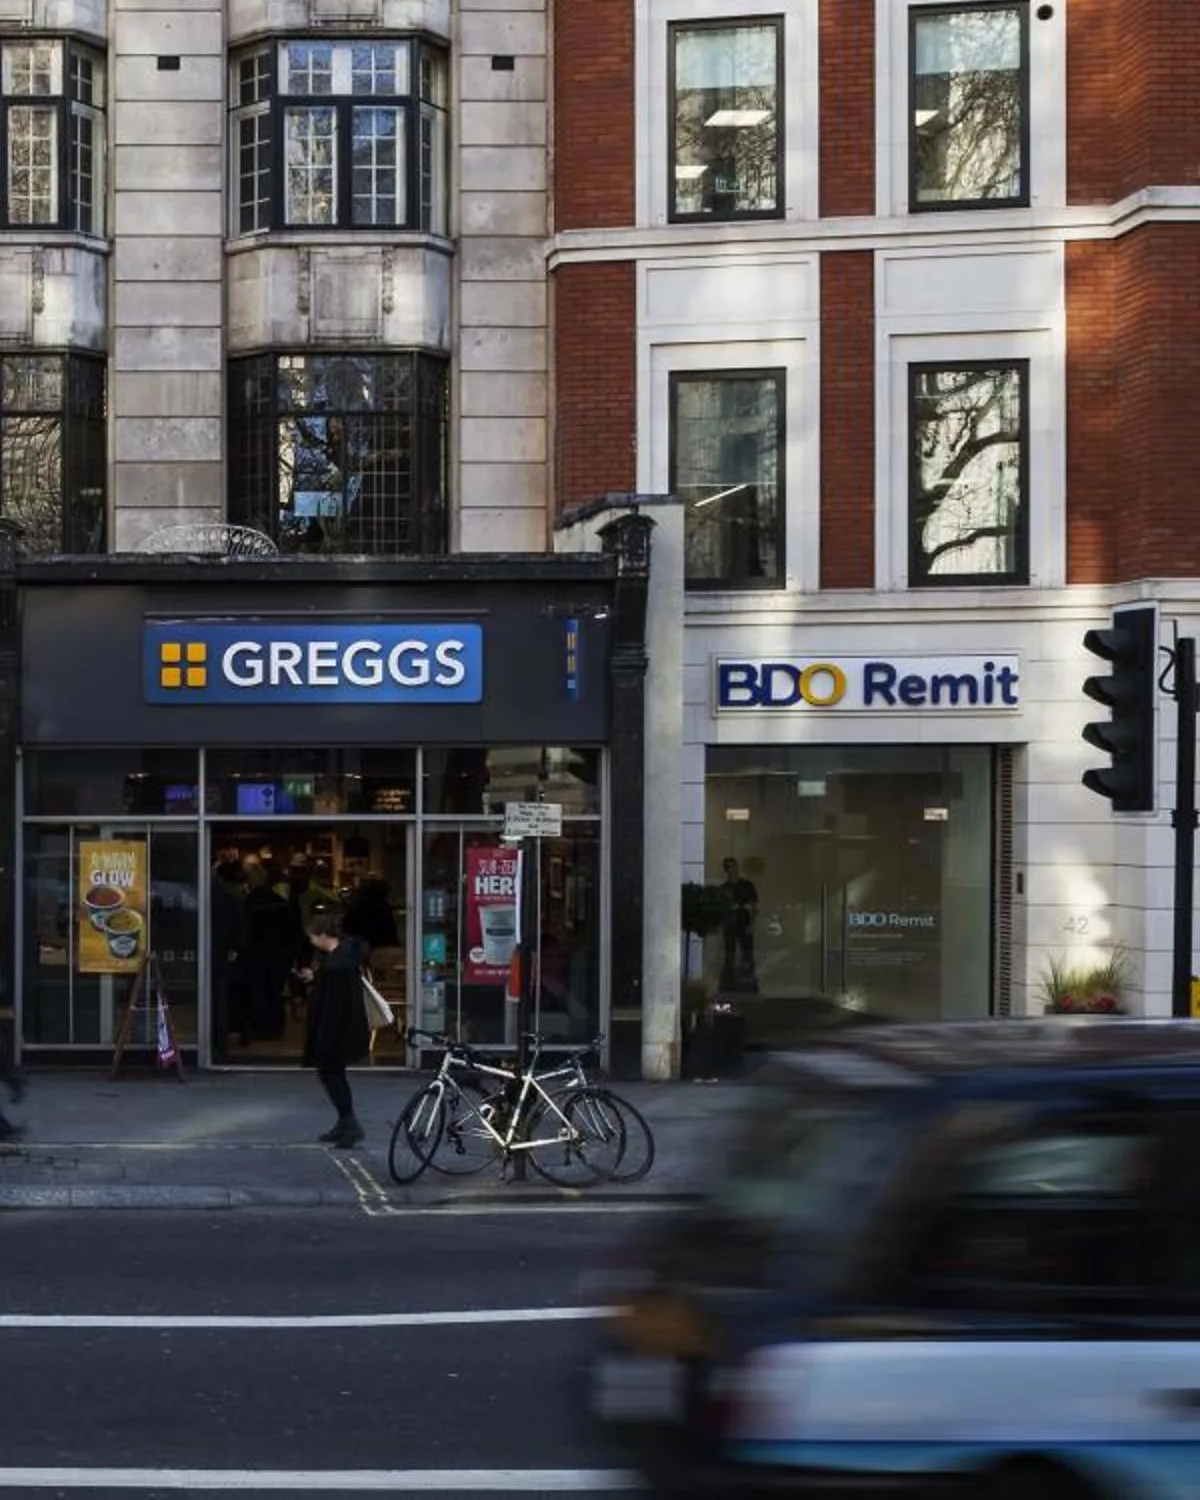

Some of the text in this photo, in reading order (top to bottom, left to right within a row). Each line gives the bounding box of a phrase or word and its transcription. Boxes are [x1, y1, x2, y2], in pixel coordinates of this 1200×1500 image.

[221, 639, 466, 688] GREGGS
[718, 661, 1019, 708] BDO Remit
[90, 869, 136, 887] GLOW
[474, 875, 518, 896] HER
[849, 911, 935, 927] BDO Remit
[1062, 916, 1090, 936] 42
